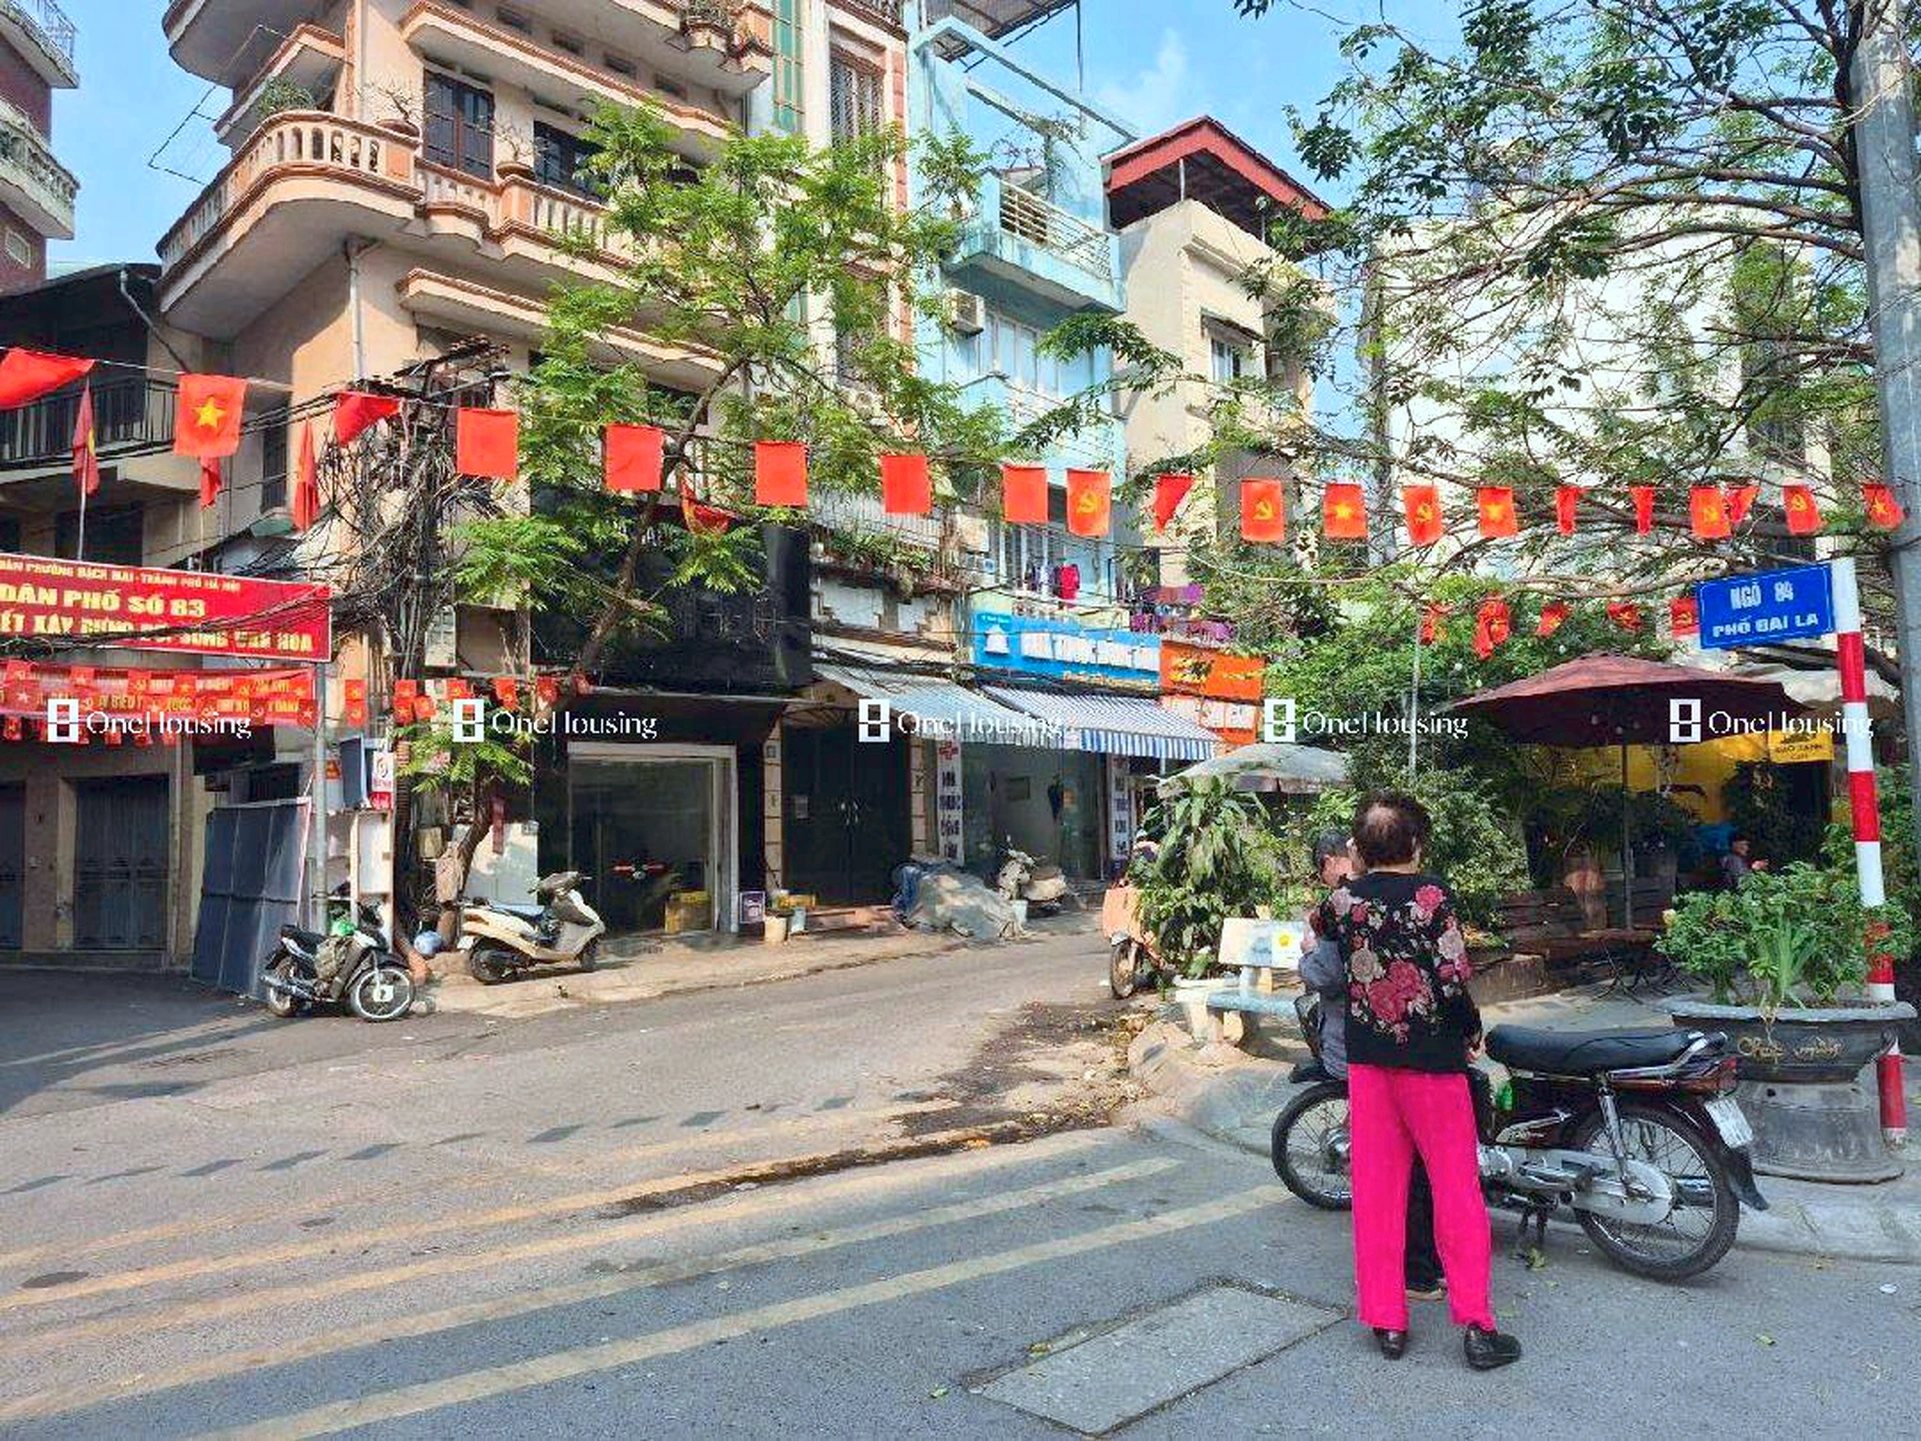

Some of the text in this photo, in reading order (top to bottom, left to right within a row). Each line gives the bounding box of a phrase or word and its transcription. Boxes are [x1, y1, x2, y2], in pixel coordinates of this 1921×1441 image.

[0, 582, 57, 606] DÂN
[64, 588, 121, 611] PHỐ
[128, 594, 165, 615] SỐ
[0, 608, 25, 633] ẾT
[33, 613, 73, 634] XÂY
[1795, 613, 1818, 627] LA
